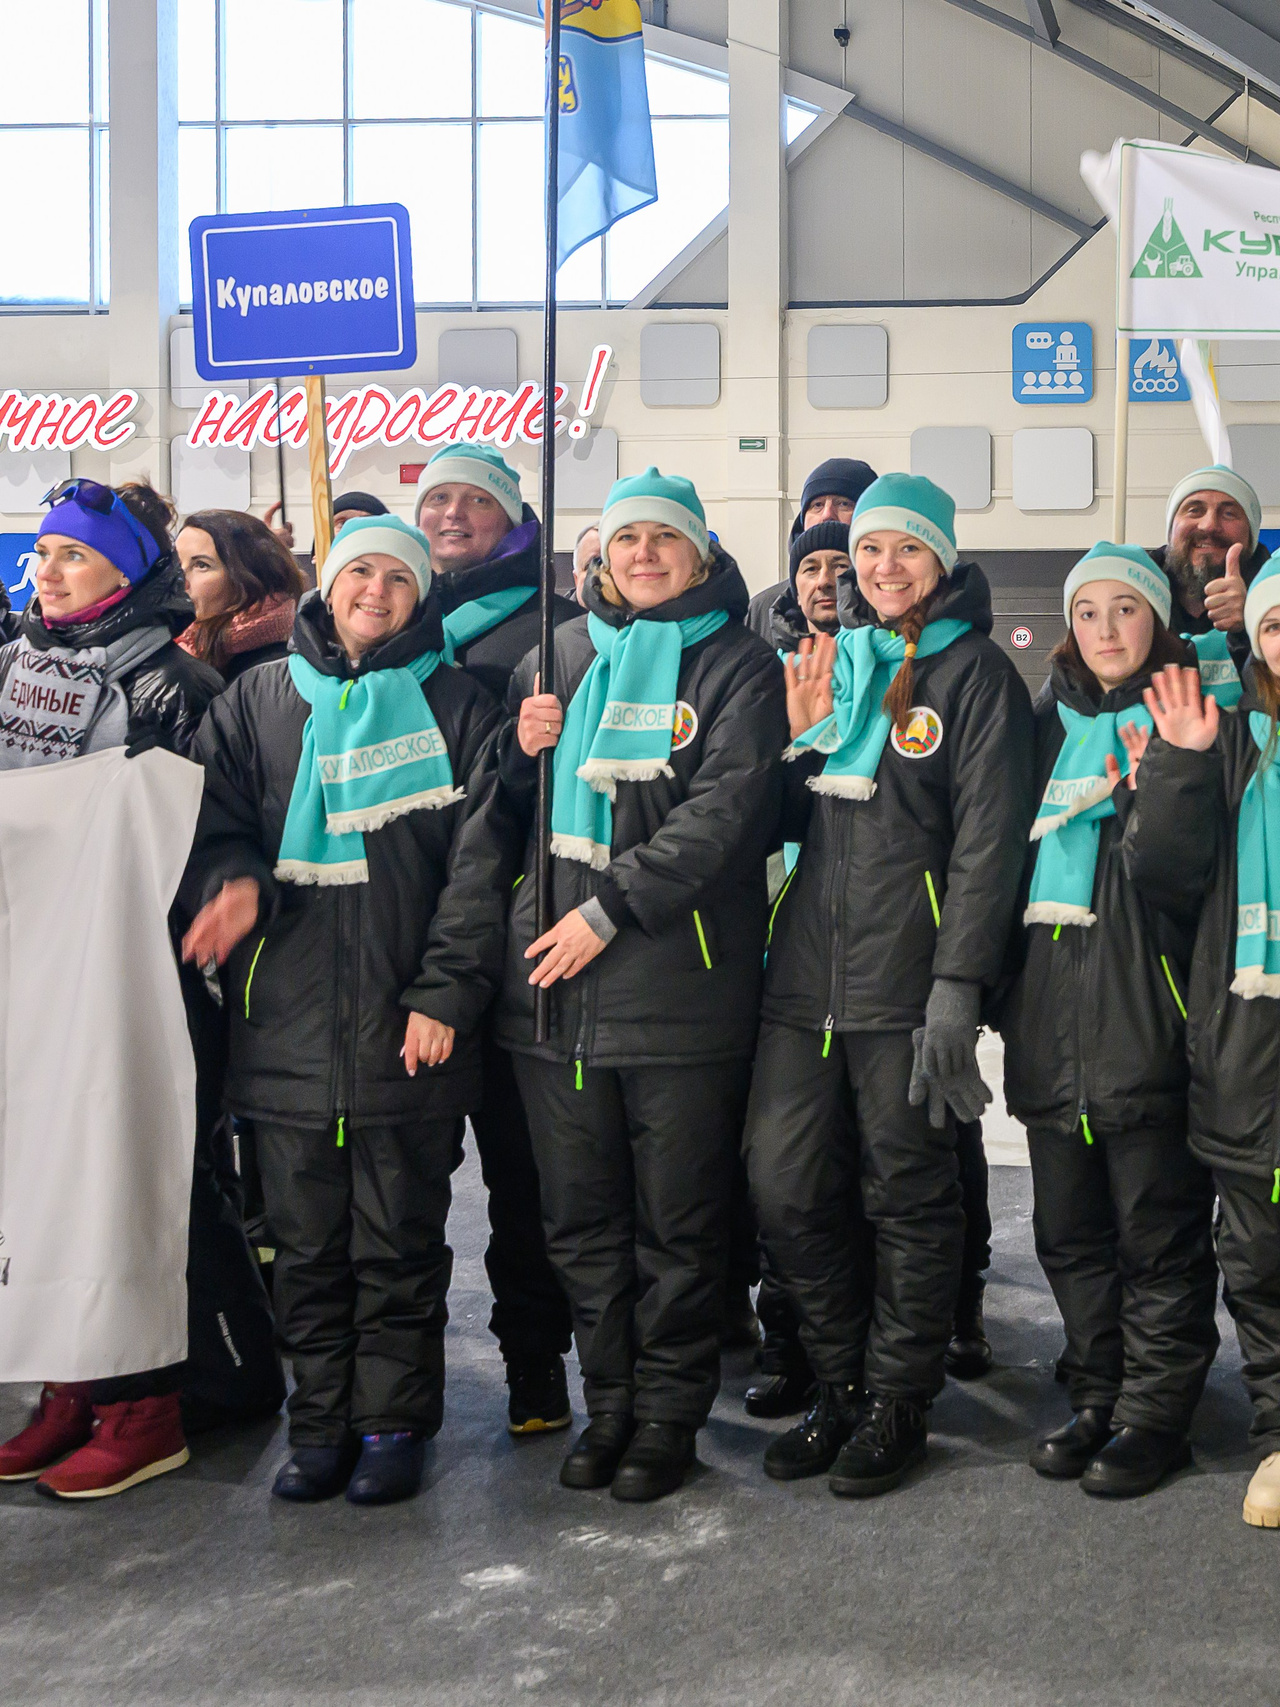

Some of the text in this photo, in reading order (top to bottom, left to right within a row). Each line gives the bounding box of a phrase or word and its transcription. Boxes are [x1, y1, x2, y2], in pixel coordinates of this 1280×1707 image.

[216, 276, 389, 317] Купаловское
[1016, 634, 1028, 642] B2
[10, 679, 86, 716] ЕДИНЫЕ
